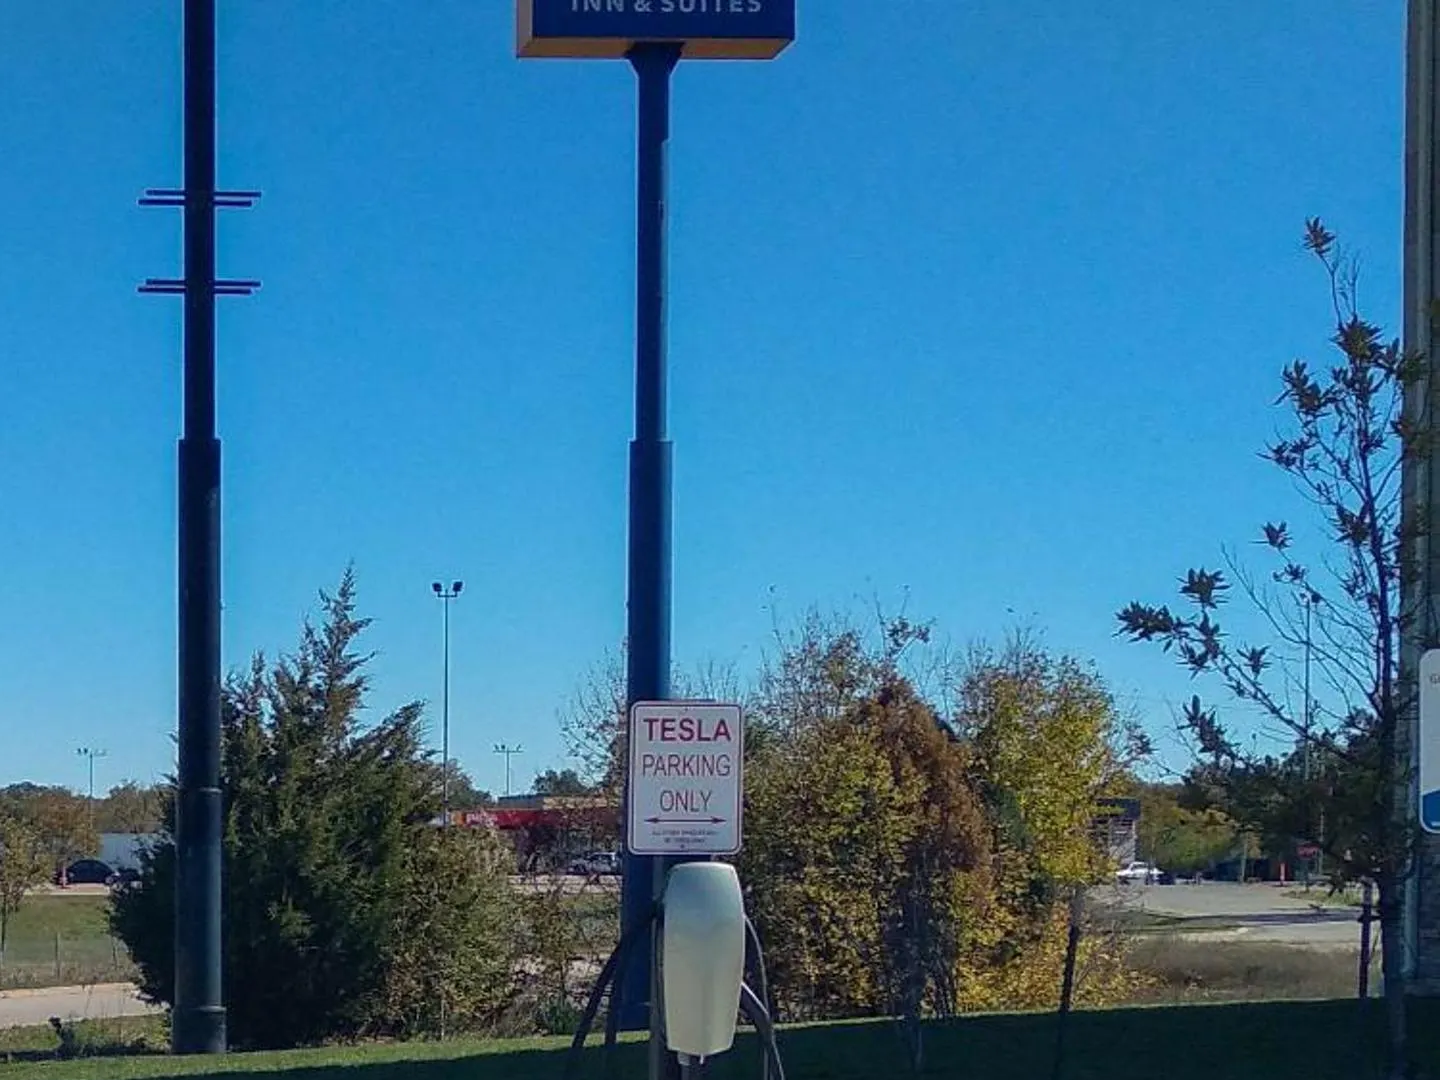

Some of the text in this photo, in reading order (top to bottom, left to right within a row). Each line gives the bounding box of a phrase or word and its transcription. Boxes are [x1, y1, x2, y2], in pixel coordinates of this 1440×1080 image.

[571, 0, 761, 12] INN & SUITES
[643, 718, 731, 742] TESLA
[642, 754, 731, 777] PARKING
[660, 790, 713, 812] ONLY
